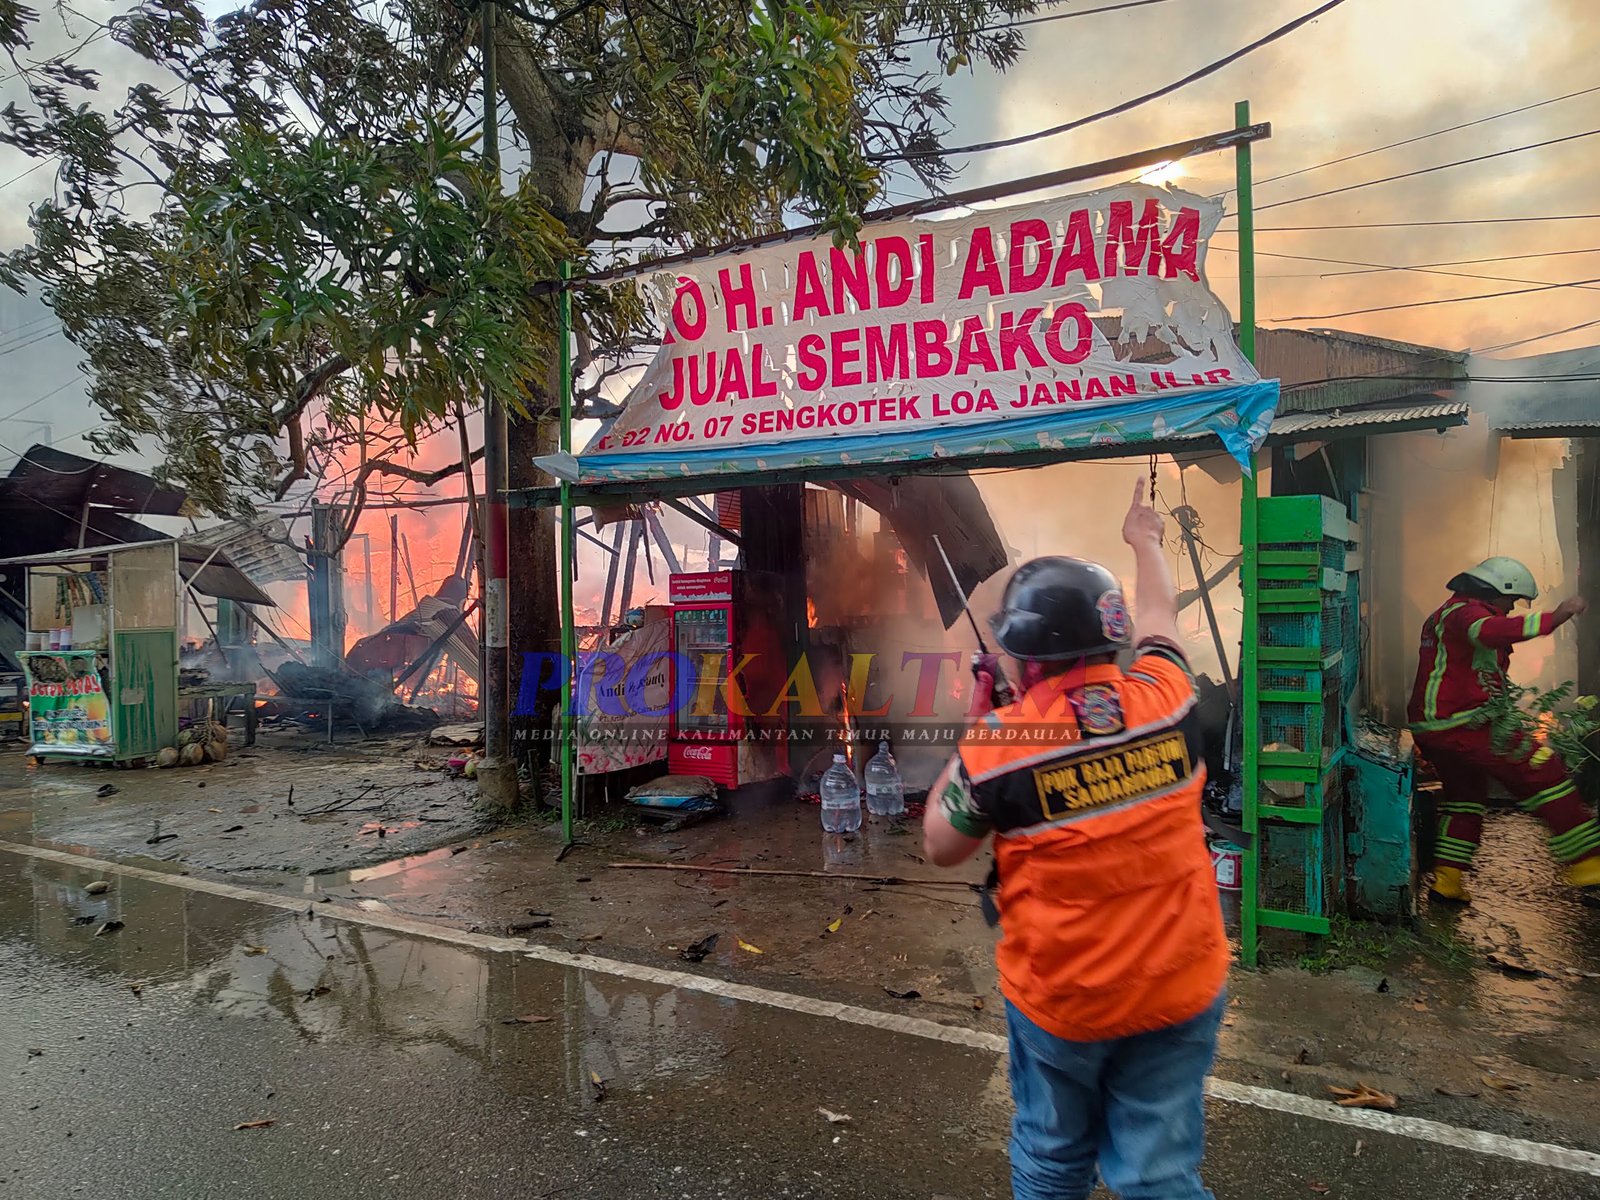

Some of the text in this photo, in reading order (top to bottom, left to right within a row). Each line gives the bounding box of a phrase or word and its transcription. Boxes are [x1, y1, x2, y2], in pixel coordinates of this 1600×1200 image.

[718, 263, 773, 333] H.
[793, 231, 934, 321] ANDI
[958, 198, 1200, 300] ADAMA
[654, 418, 695, 445] NO.
[704, 414, 734, 439] 07
[741, 394, 921, 435] SENGKOTEK
[932, 388, 999, 418] LOA
[1010, 373, 1138, 409] JANAN
[658, 302, 1094, 411] JUAL SEMBAKO
